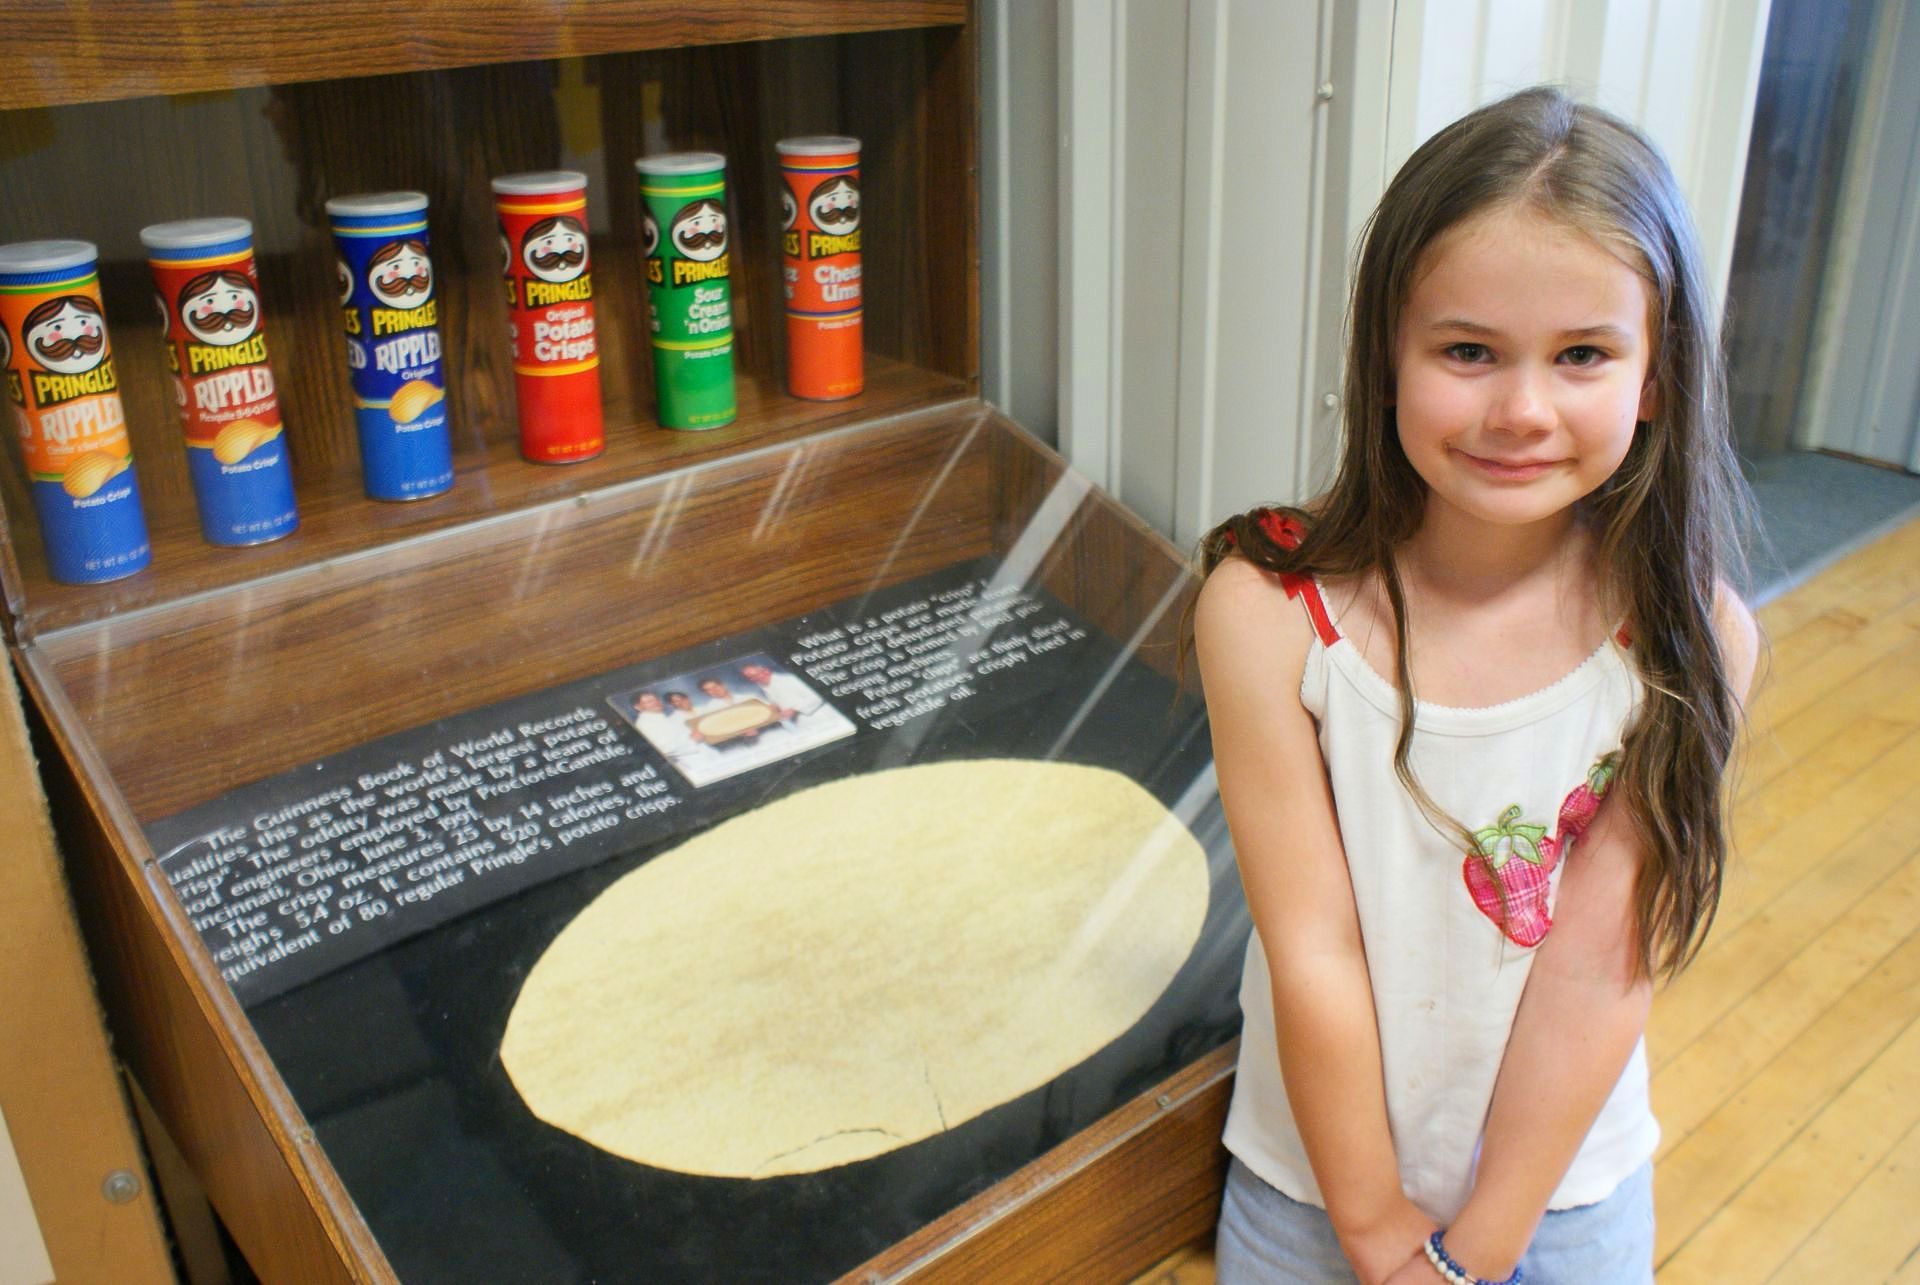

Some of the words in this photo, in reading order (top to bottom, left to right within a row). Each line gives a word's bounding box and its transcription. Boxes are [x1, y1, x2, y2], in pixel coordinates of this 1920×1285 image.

[810, 228, 862, 257] PRINGL
[546, 305, 586, 322] Original
[688, 301, 728, 319] Cream
[694, 287, 724, 305] Sour
[188, 333, 268, 373] PRINGLES
[534, 316, 594, 342] Potato
[535, 337, 595, 361] Crisps
[35, 360, 116, 404] PRINGLES
[193, 366, 275, 413] RIPPLED
[40, 396, 124, 446] RIPPLED
[221, 465, 252, 474] Potato
[73, 496, 106, 508] Potato
[790, 641, 849, 666] Potato
[853, 624, 901, 646] crisps
[906, 613, 932, 629] are
[935, 599, 977, 618] made
[798, 628, 845, 649] What
[845, 623, 862, 634] is
[866, 617, 879, 628] a
[881, 600, 930, 625] potato
[805, 642, 884, 680] processed
[886, 613, 967, 649] dehydrated
[816, 670, 849, 686] The
[851, 656, 888, 675] crisp
[887, 652, 905, 662] is
[904, 630, 961, 656] formed
[855, 697, 901, 720] fresh
[903, 671, 975, 704] potatoes
[977, 650, 1029, 675] crisply
[1027, 634, 1067, 655] fried
[1067, 627, 1087, 641] in
[862, 677, 913, 701] Potato
[968, 650, 992, 664] are
[990, 635, 1029, 654] thinly
[1031, 618, 1070, 640] sliced
[831, 672, 888, 697] cessing
[870, 696, 948, 730] vegetable
[167, 843, 249, 885] ualifies
[257, 825, 298, 848] this
[307, 811, 333, 829] as
[340, 793, 377, 815] the
[384, 765, 462, 798] world's
[465, 739, 537, 770] largest
[543, 718, 608, 748] potato
[203, 826, 247, 851] The
[253, 786, 352, 831] Guinness
[358, 761, 416, 791] Book
[422, 751, 445, 769] of
[450, 728, 515, 758] World
[518, 706, 597, 738] Records
[247, 844, 291, 869] The
[300, 813, 369, 849] oddity
[376, 797, 420, 818] was
[426, 772, 483, 800] made
[487, 763, 515, 780] by
[523, 756, 538, 769] a
[542, 738, 593, 762] team
[598, 729, 619, 746] of
[185, 890, 222, 916] od
[230, 847, 332, 897] engineers
[340, 803, 440, 851] employed
[443, 793, 471, 812] by
[213, 925, 283, 964] eighs
[295, 903, 330, 929] 5.4
[338, 890, 373, 910] oz.
[378, 876, 399, 893] It
[406, 839, 496, 882] contains
[500, 820, 541, 845] 920
[549, 794, 633, 828] calories,
[634, 779, 669, 799] the
[221, 910, 268, 938] The
[278, 884, 334, 916] crisp
[341, 839, 446, 890] measures
[452, 824, 480, 846] 25
[482, 814, 512, 833] by
[519, 801, 544, 820] 14
[547, 780, 615, 811] inches
[619, 763, 658, 787] and
[192, 885, 291, 932] incinnati,
[297, 858, 357, 887] Ohio,
[360, 836, 408, 864] June
[222, 929, 322, 983] quivalent
[328, 912, 353, 935] of
[358, 900, 389, 922] 80
[395, 868, 464, 905] regular
[469, 837, 554, 877] Pringle's
[557, 813, 620, 847] potato
[625, 795, 682, 822] crisps.
